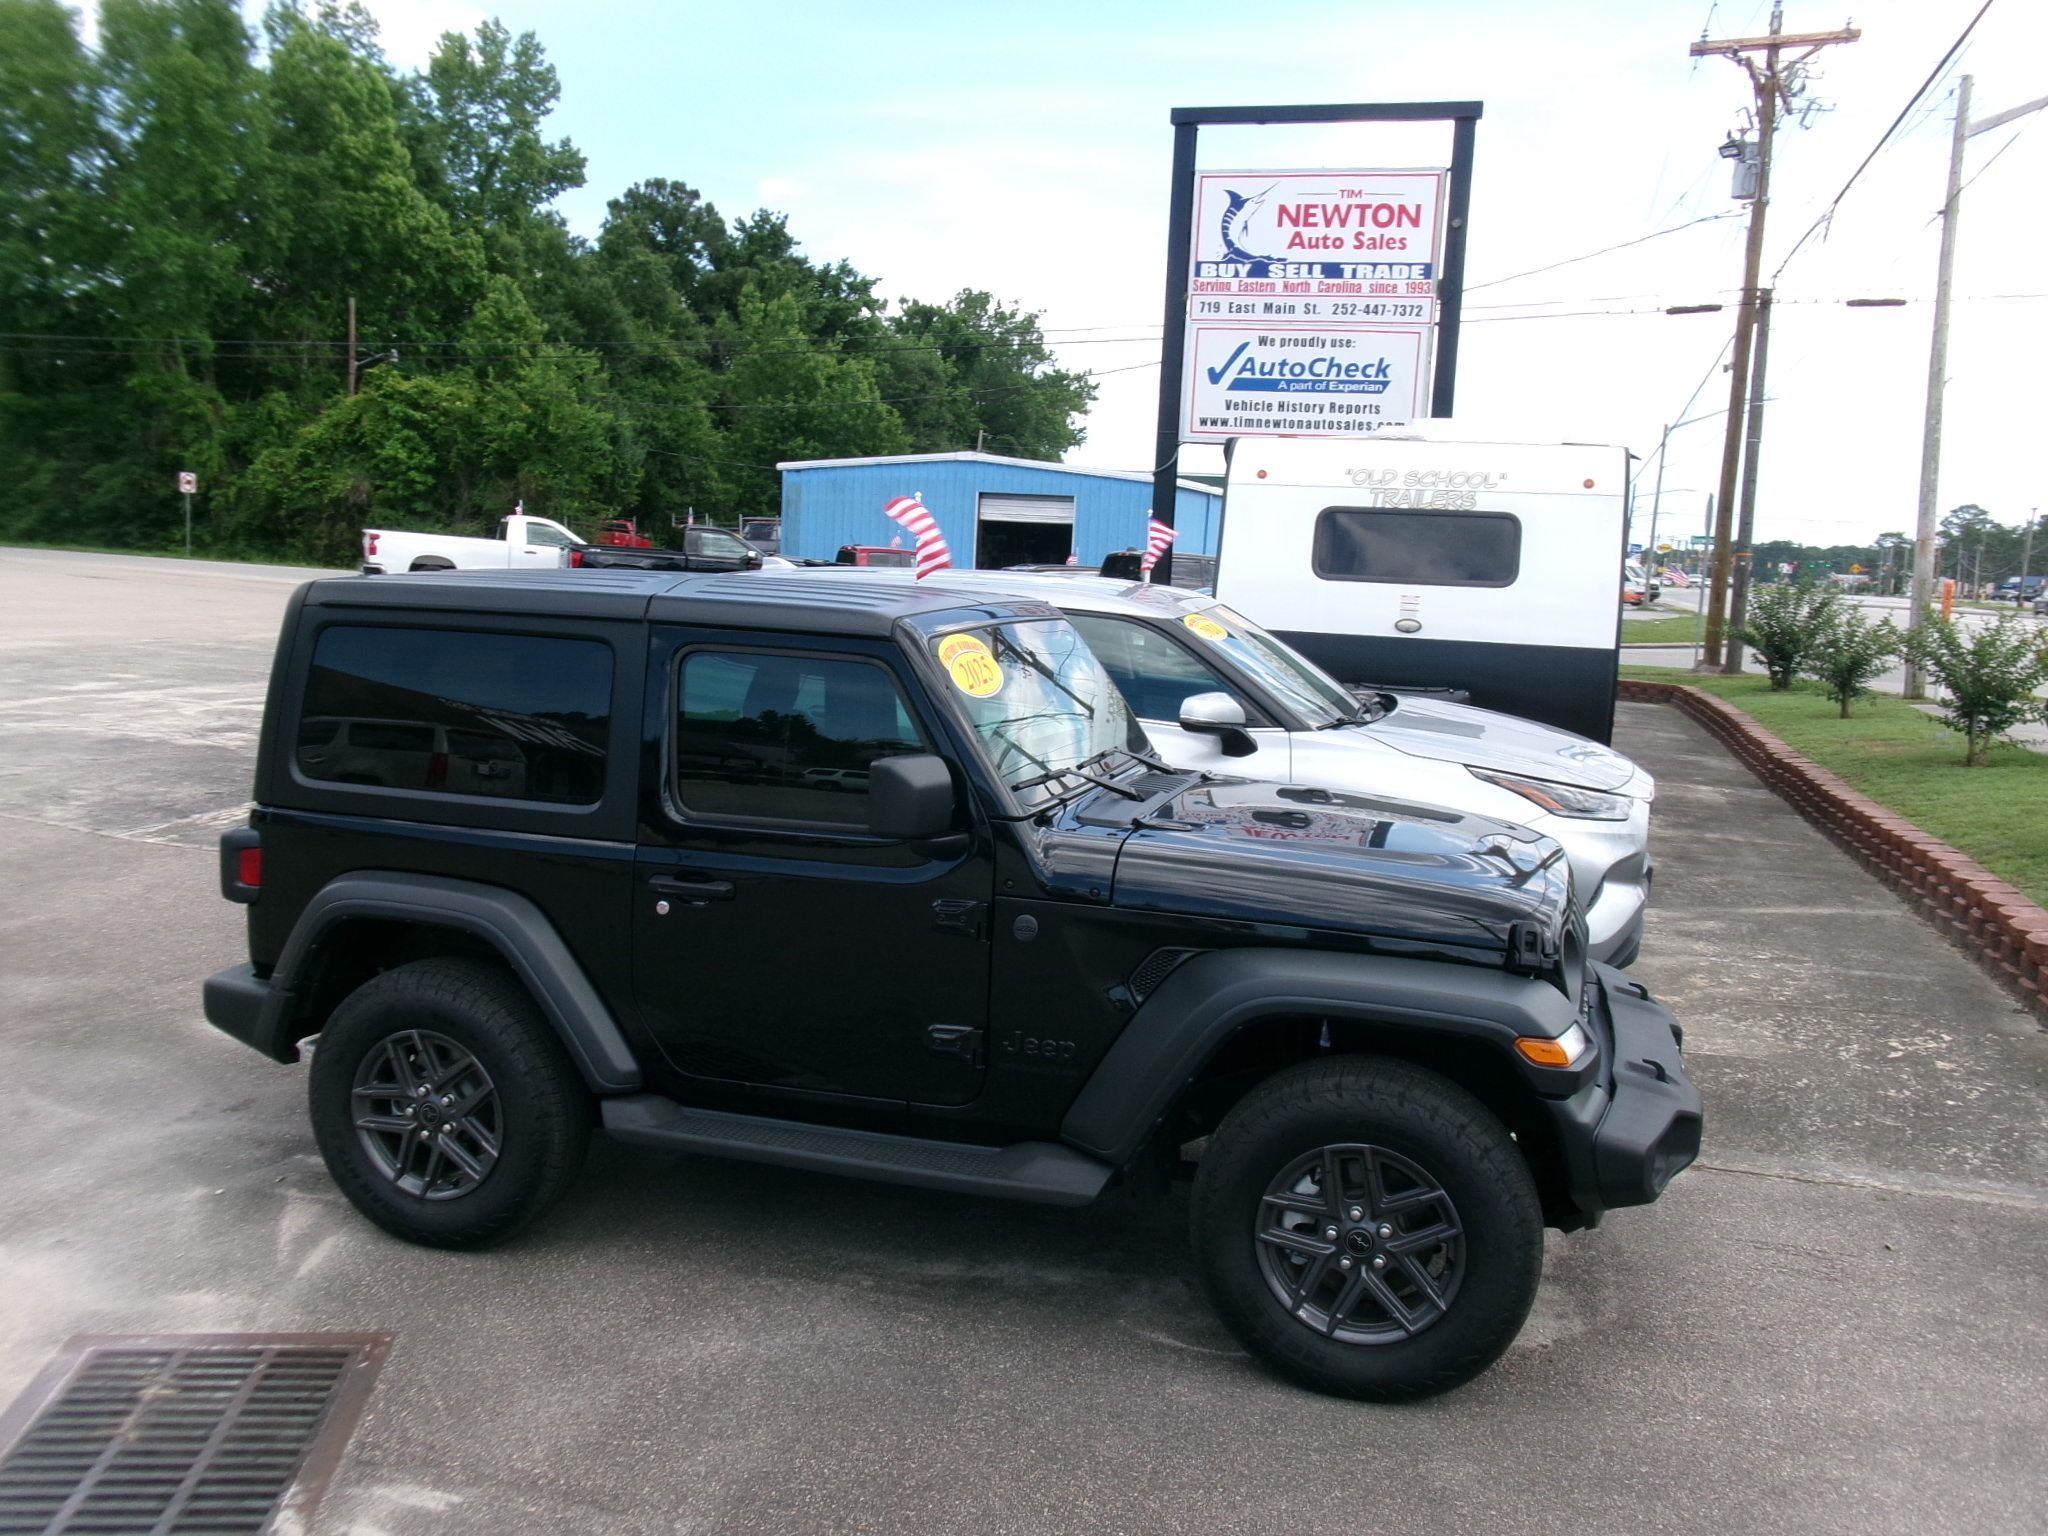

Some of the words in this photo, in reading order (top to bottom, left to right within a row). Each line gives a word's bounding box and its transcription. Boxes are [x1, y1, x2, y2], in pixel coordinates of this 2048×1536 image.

[1338, 189, 1363, 199] TIM
[1277, 203, 1422, 228] NEWTON
[1287, 231, 1344, 250] Auto
[1352, 231, 1408, 250] Sales
[1200, 263, 1252, 278] BUY
[1268, 264, 1325, 279] SELL
[1340, 265, 1426, 279] TRADE
[1192, 279, 1232, 293] Serving
[1238, 280, 1276, 292] Eastern
[1282, 281, 1311, 293] North
[1317, 281, 1362, 294] Carolina
[1369, 282, 1398, 294] since
[1405, 281, 1432, 294] 1993
[1199, 301, 1221, 313] 719
[1228, 302, 1256, 314] East
[1263, 302, 1296, 314] Main
[1303, 303, 1322, 315] St.
[1332, 303, 1424, 317] 252-447-7372
[1258, 335, 1276, 347] We
[1279, 336, 1327, 348] proudly
[1331, 338, 1356, 348] use:
[1236, 356, 1393, 378] AutoCheck
[1278, 381, 1288, 390] A
[1289, 382, 1313, 392] part
[1315, 381, 1328, 391] of
[1329, 381, 1384, 393] Experian
[1225, 399, 1273, 412] Vehicle
[1278, 401, 1325, 414] History
[1329, 402, 1381, 414] Reports
[1370, 488, 1477, 510] TRAILERS
[958, 655, 994, 690] 2025
[1002, 1030, 1077, 1060] Jeep
